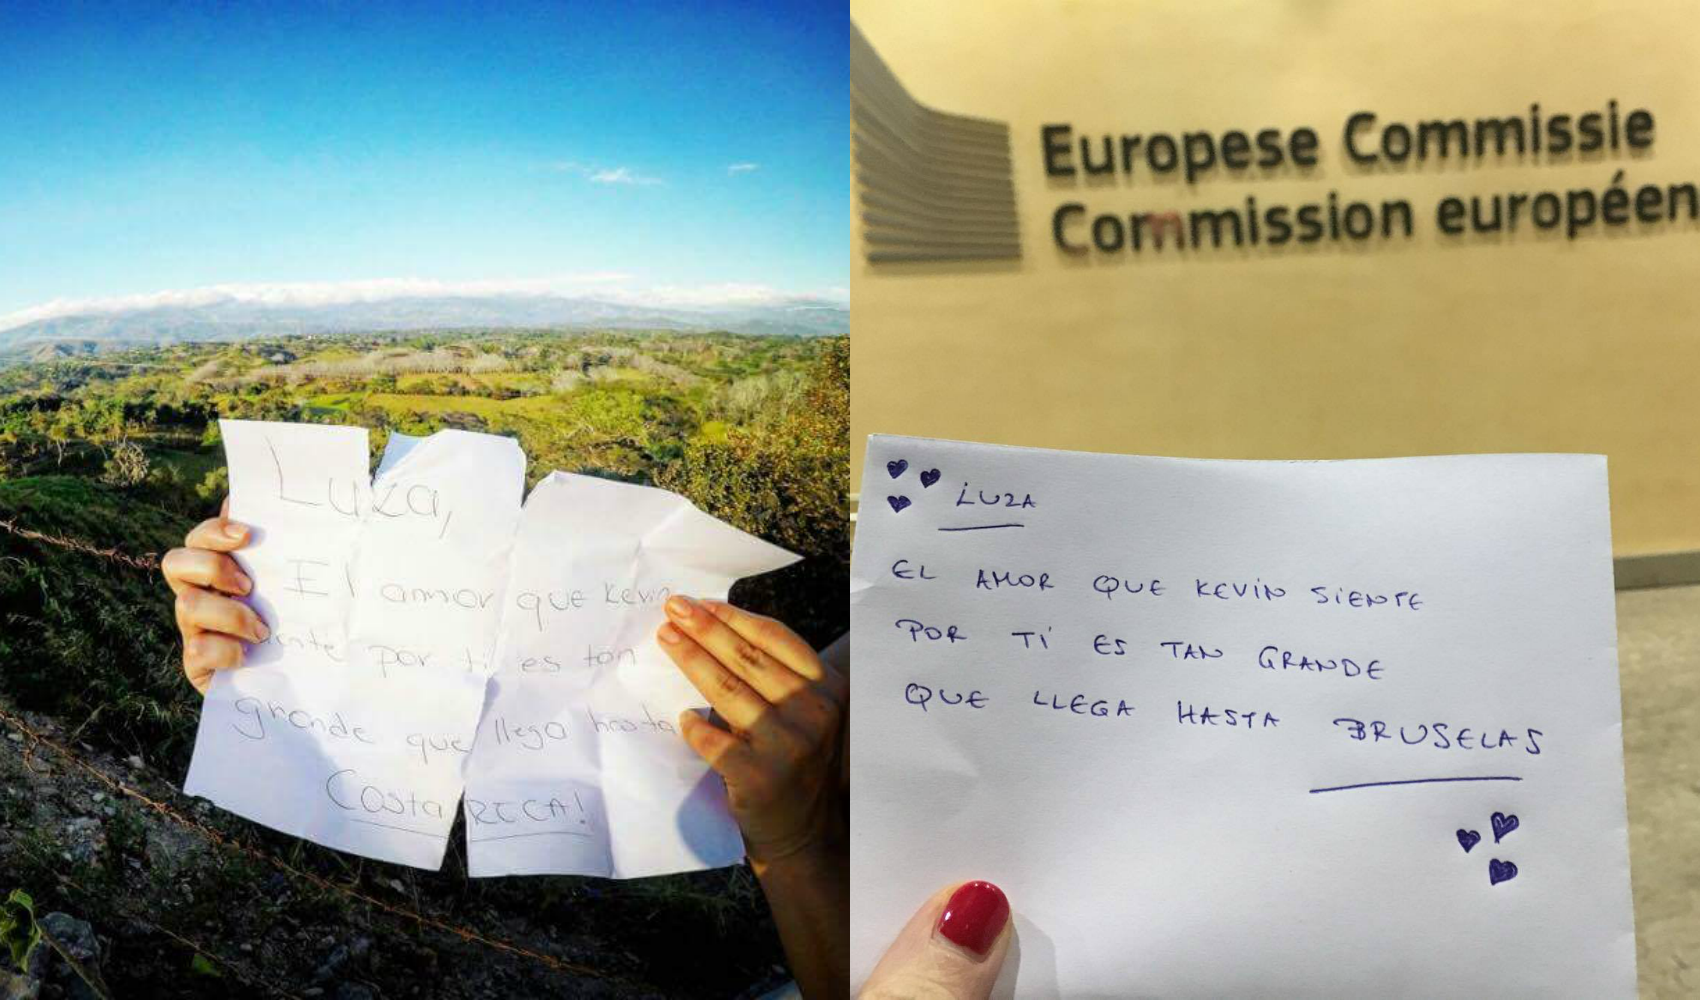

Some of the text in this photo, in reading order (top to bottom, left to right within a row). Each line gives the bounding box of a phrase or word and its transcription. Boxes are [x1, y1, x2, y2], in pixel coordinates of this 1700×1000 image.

[1040, 98, 1656, 185] Europese Commissie
[1052, 168, 1700, 256] Commission européen
[955, 482, 1037, 509] LUZA
[283, 558, 356, 601] El
[380, 582, 495, 609] amor
[516, 587, 586, 633] que
[891, 559, 937, 580] EL
[976, 569, 1055, 590] AMOR
[1093, 575, 1167, 599] QUE
[368, 645, 430, 679] por
[520, 656, 562, 674] es
[895, 618, 967, 643] POR
[1093, 635, 1128, 656] ES
[1161, 641, 1224, 661] TAN
[1258, 645, 1385, 680] GRANDE
[905, 683, 1544, 755] QUE LLEGA HASTA BRUSELAS
[406, 732, 473, 764] que
[326, 768, 443, 819] Costa
